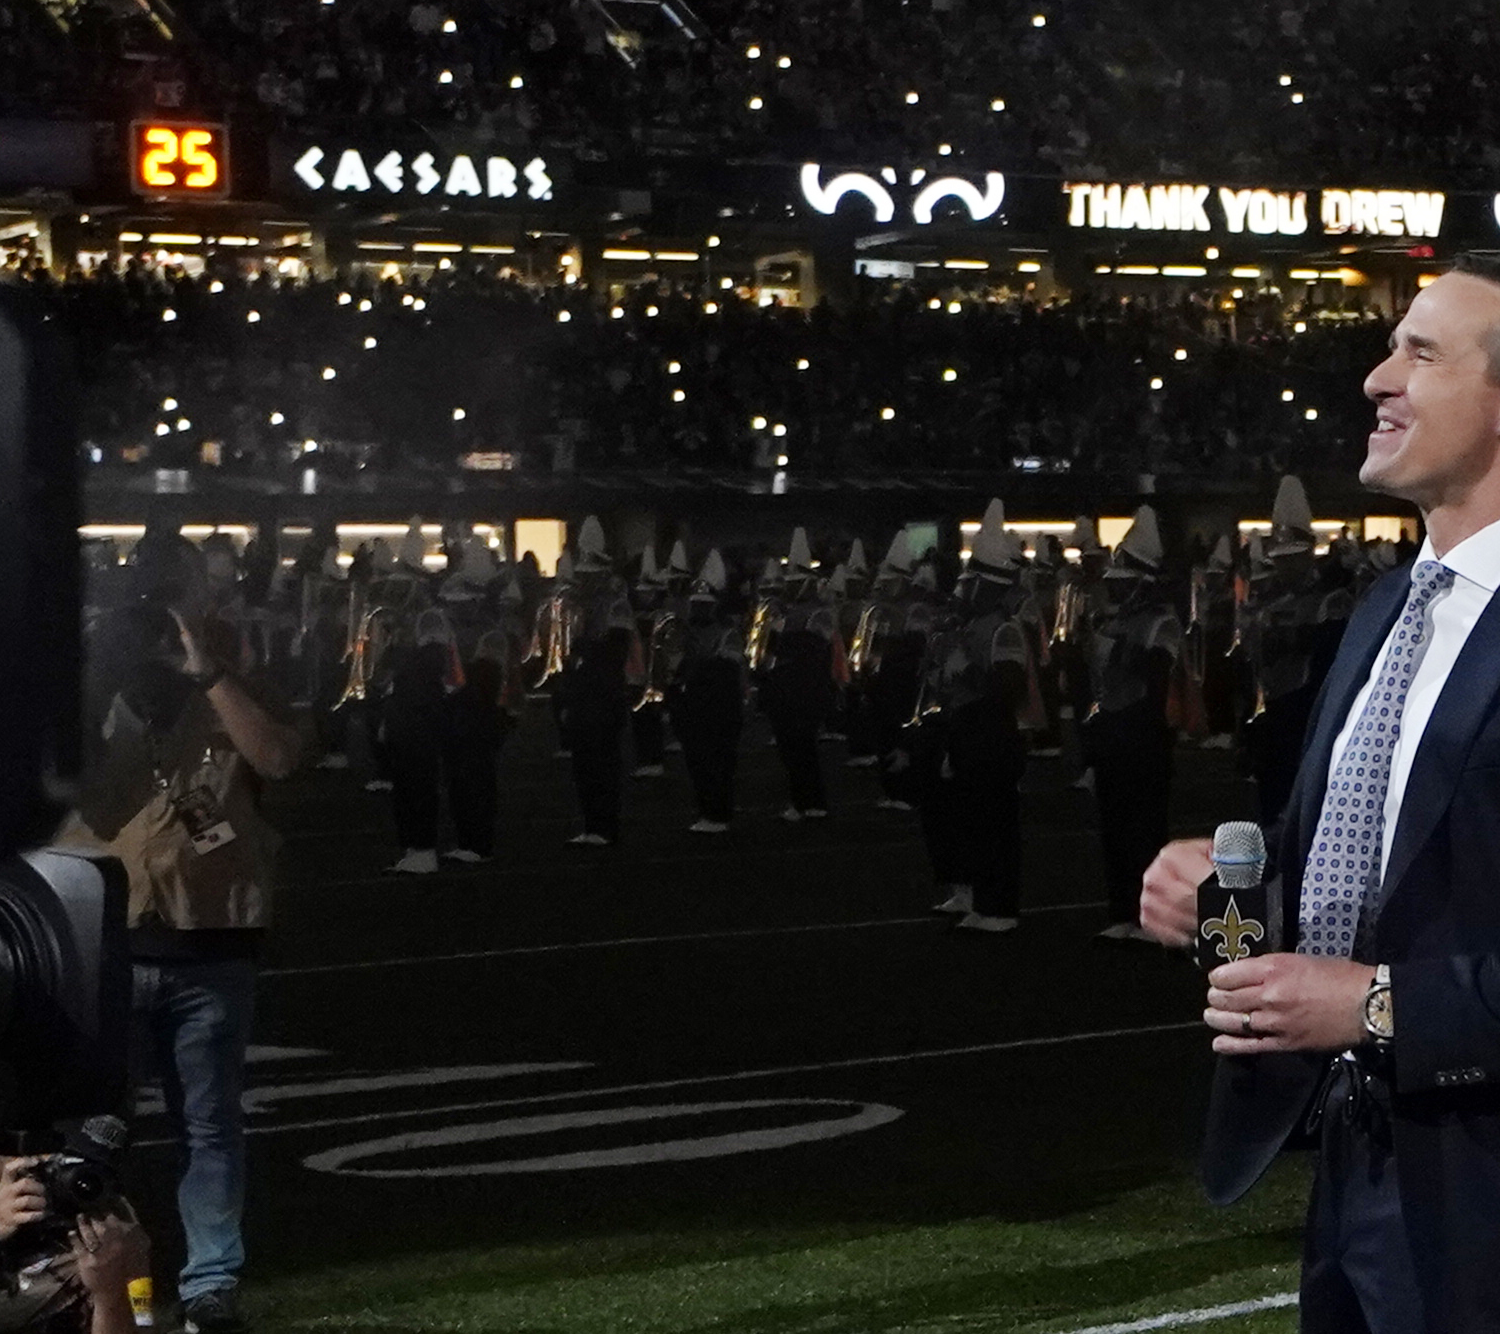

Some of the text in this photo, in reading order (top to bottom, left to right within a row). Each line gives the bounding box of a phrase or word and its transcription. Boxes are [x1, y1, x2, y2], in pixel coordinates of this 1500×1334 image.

[143, 129, 218, 187] 25
[1064, 183, 1445, 237] THANK YOU DREW
